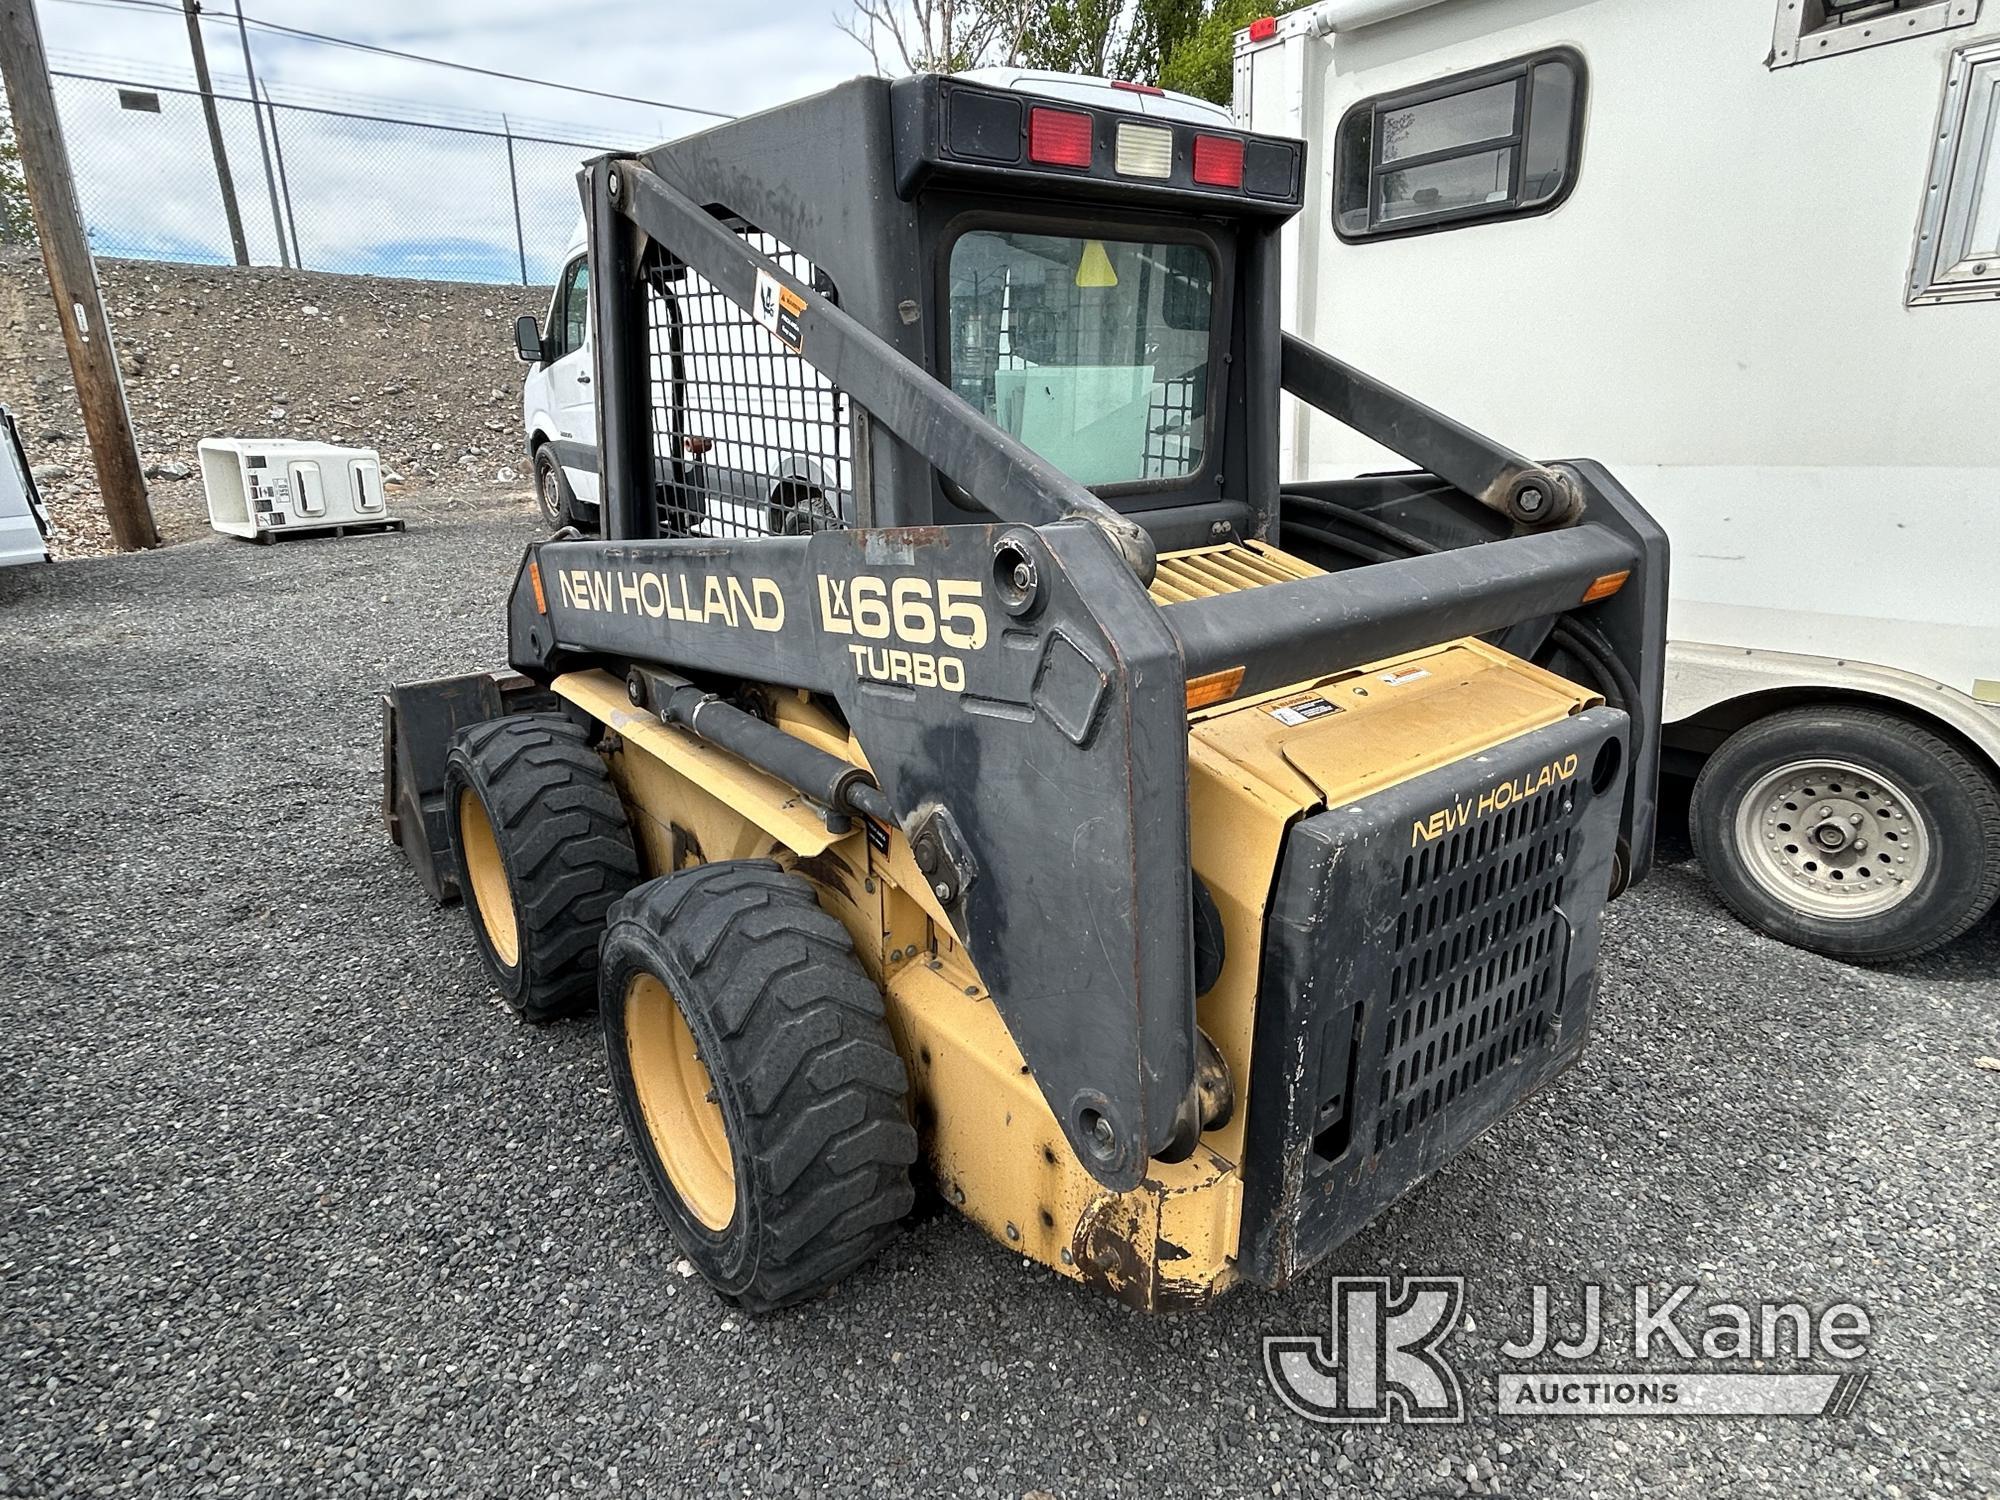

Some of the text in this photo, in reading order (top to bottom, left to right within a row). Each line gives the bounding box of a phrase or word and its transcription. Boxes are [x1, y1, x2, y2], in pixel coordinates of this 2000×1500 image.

[558, 569, 785, 633] NEW HOLLAND
[848, 643, 966, 692] TURBO
[1411, 753, 1578, 848] NEW HOLLAND
